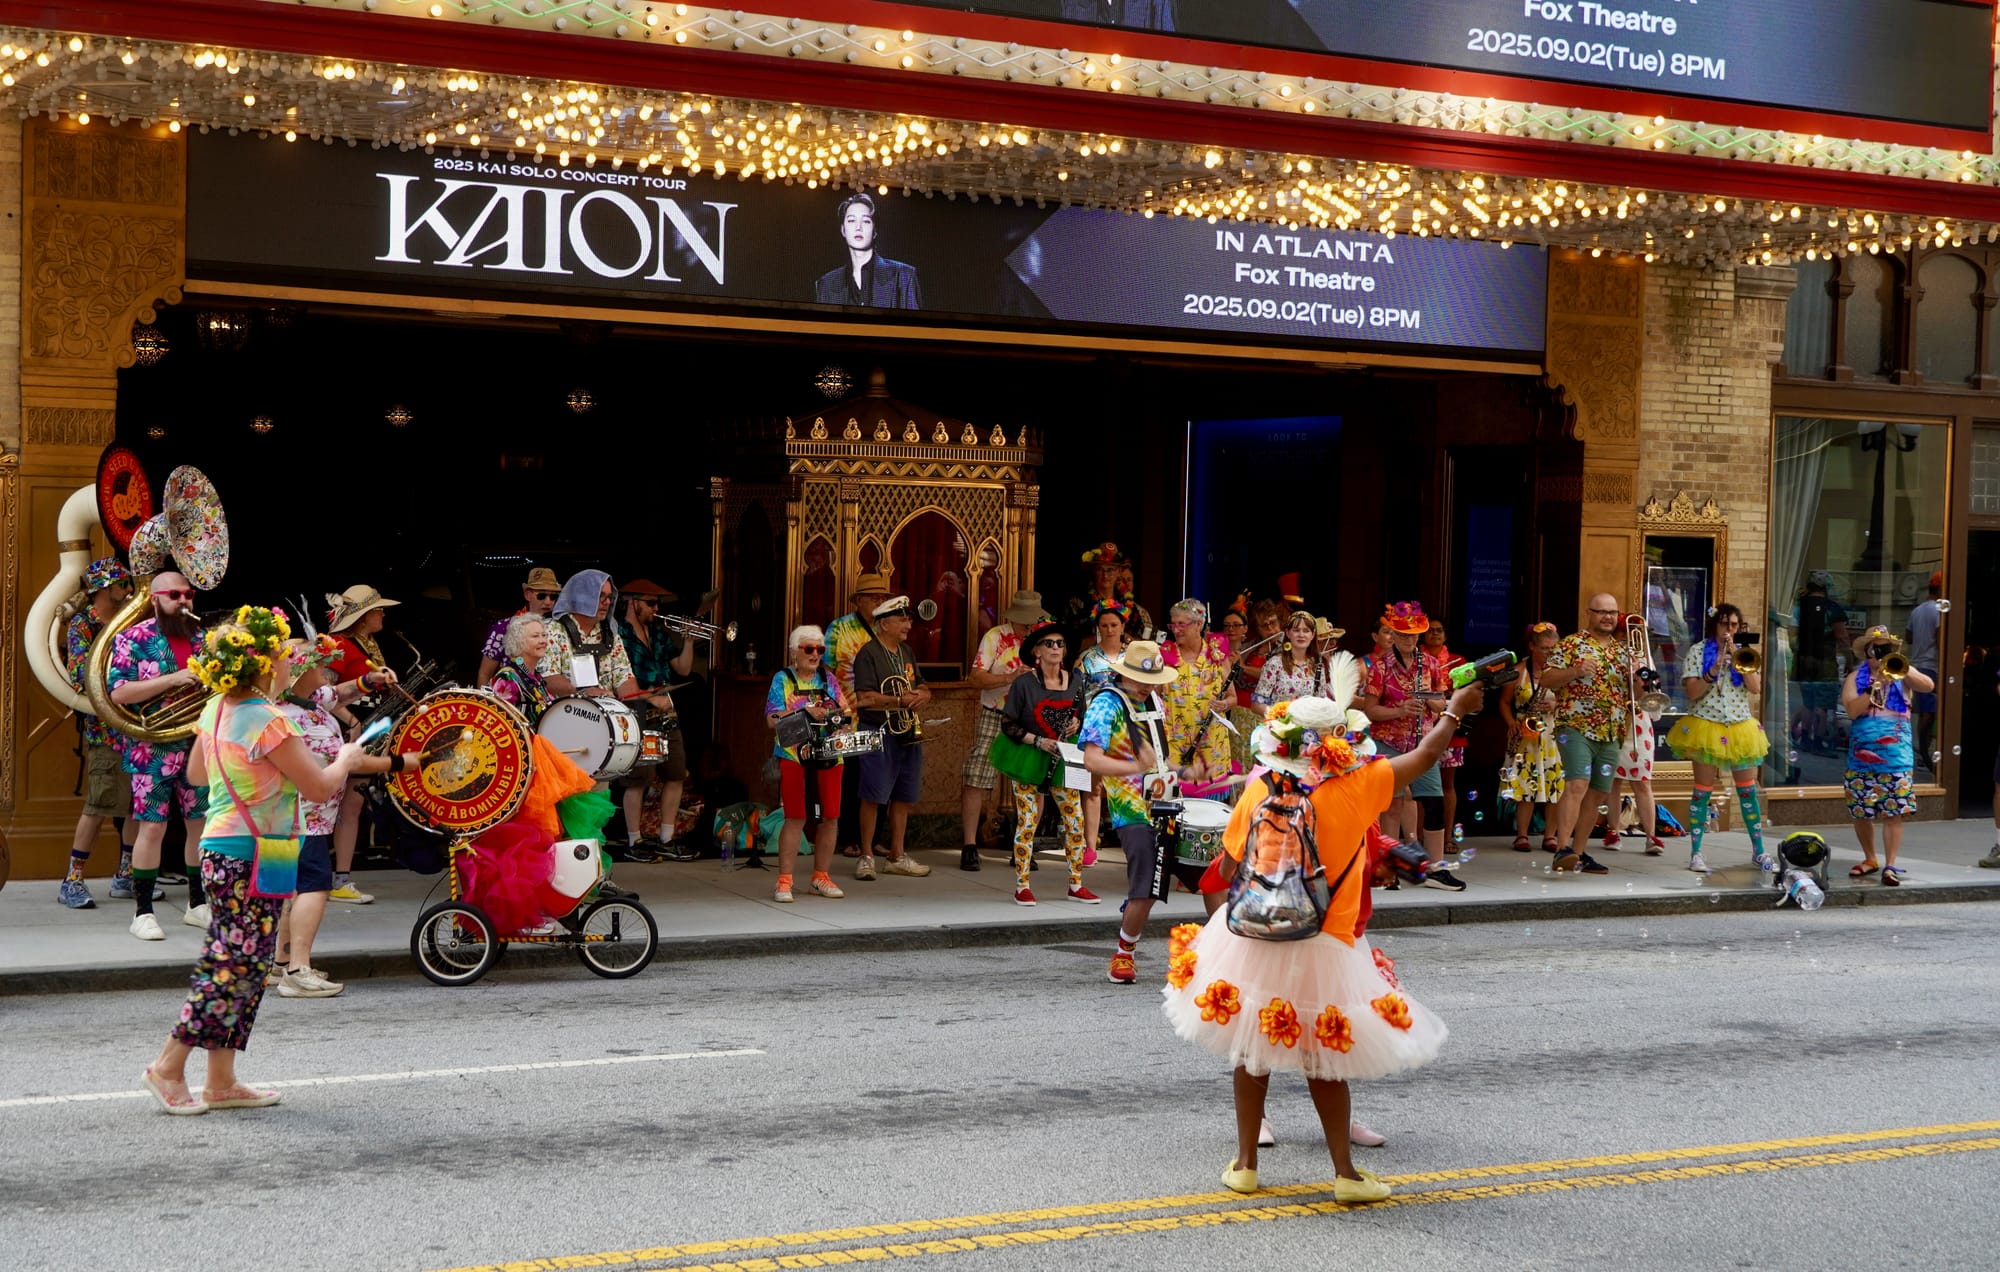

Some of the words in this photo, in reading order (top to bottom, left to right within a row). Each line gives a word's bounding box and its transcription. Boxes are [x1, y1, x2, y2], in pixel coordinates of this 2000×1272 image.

[1524, 0, 1573, 23] Fox
[1578, 2, 1677, 36] Theatre
[1467, 28, 1665, 76] 2025.09.02(Tue)
[1670, 53, 1725, 80] 8PM
[434, 158, 474, 172] 2025
[477, 162, 506, 175] KAI
[510, 165, 555, 179] SOLO
[560, 169, 639, 186] CONCERT
[642, 176, 687, 190] TOUR
[375, 172, 738, 286] KAION
[1216, 230, 1244, 252] IN
[1252, 234, 1394, 264] ATLANTA
[1235, 262, 1279, 285] Fox
[1284, 267, 1375, 292] Theatre
[1183, 294, 1364, 328] 2025.09.02(Tue)
[1369, 308, 1420, 329] 8PM
[109, 456, 127, 474] SEED
[410, 706, 451, 742] SEED
[457, 704, 470, 721] &
[473, 708, 512, 748] FEED
[572, 706, 601, 723] YAMAHA
[403, 773, 446, 816] ARCHING
[1156, 846, 1164, 864] VIC
[1152, 864, 1162, 896] FIRTH
